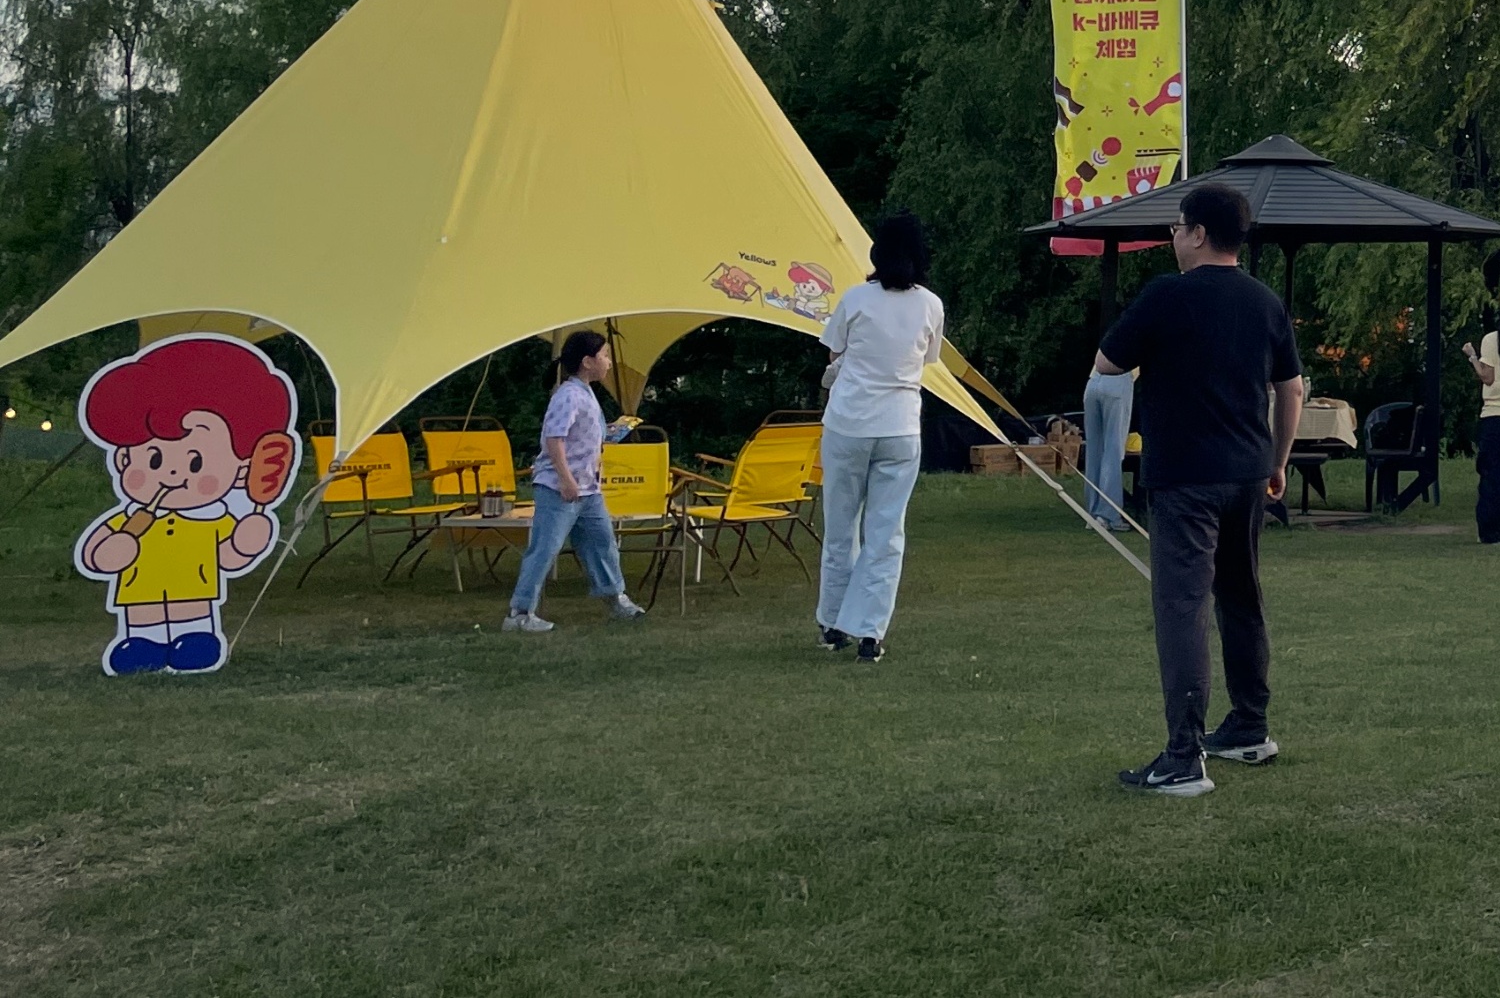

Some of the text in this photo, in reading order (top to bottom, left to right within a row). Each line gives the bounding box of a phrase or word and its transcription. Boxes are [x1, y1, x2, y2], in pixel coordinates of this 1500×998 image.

[1072, 10, 1160, 32] k-바베큐
[1095, 38, 1137, 59] 체험
[738, 251, 777, 267] Yellows
[611, 475, 645, 484] CHAIR
